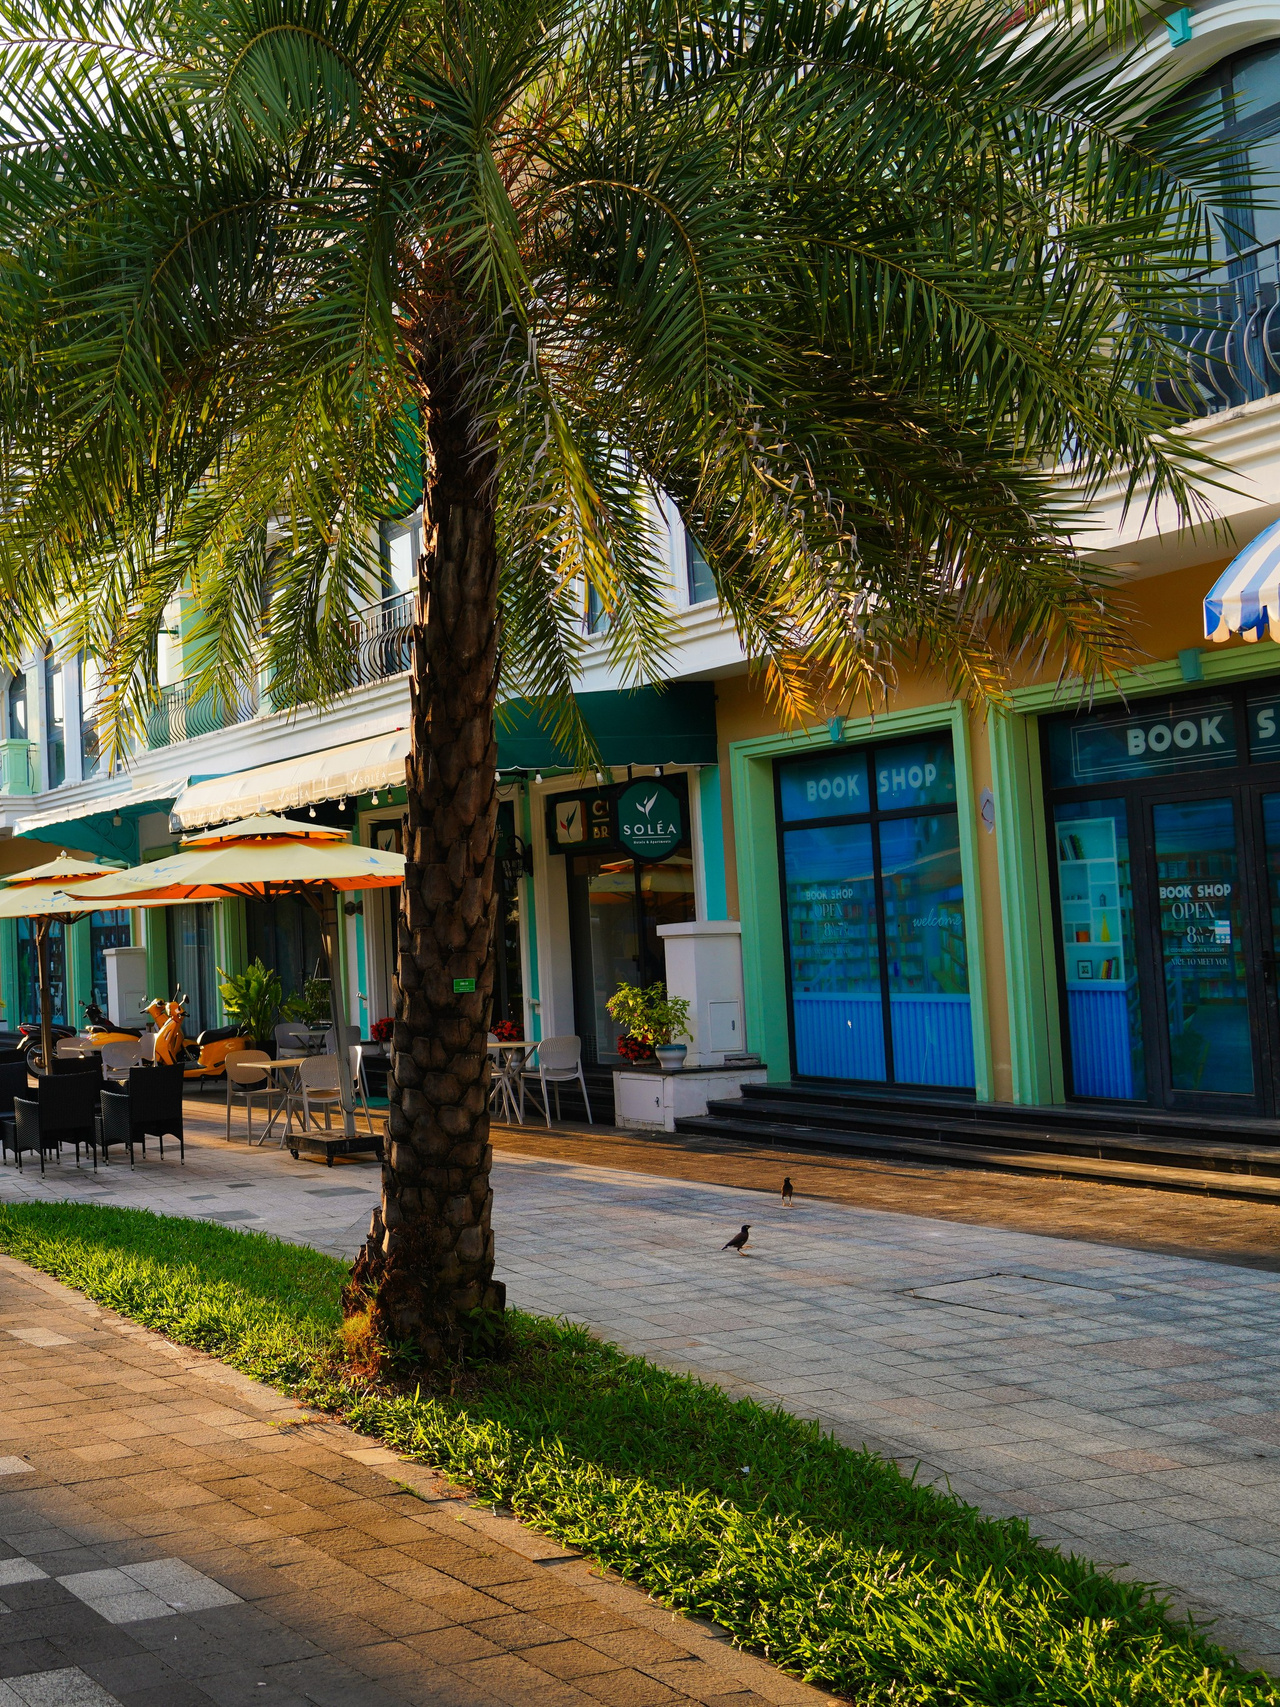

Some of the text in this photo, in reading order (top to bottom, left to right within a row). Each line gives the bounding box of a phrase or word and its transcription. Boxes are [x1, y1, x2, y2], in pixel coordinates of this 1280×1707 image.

[1126, 715, 1226, 756] BOOK
[806, 763, 937, 802] BOOK SHOP
[623, 820, 677, 835] SOLÉA
[806, 888, 853, 901] BOOK SHOP
[1159, 883, 1231, 899] BOOK SHOP
[814, 902, 843, 918] OPEN
[912, 907, 963, 928] welcome
[1172, 902, 1215, 920] OPEN
[1187, 958, 1196, 966] TO
[1196, 957, 1214, 966] MEET
[1214, 957, 1229, 965] YOU
